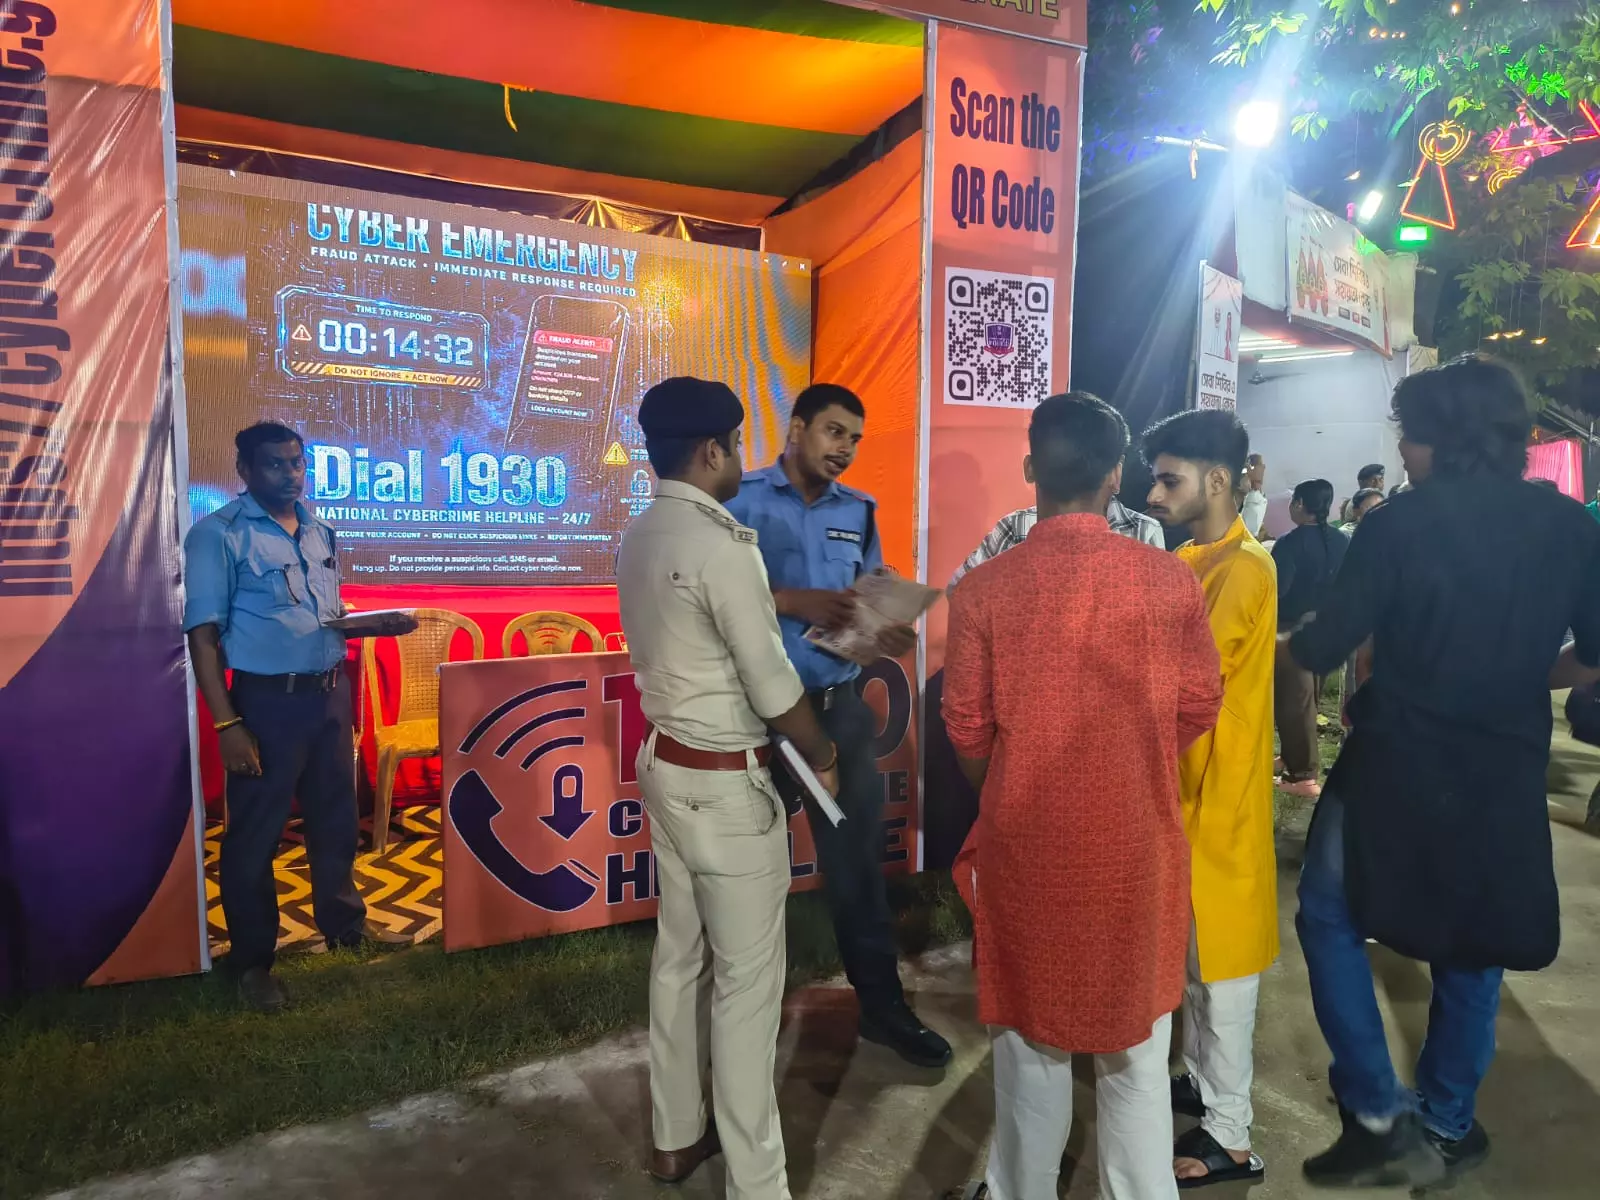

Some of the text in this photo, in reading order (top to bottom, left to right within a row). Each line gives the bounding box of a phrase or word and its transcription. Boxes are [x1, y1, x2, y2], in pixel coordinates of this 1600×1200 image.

[950, 76, 1061, 153] Scan the
[951, 163, 1056, 235] QR Code
[307, 202, 638, 282] CYBER EMERGENCY
[310, 246, 636, 298] FRAUD ATTACK IMMEDIATE RESPONSE REQUIRED
[355, 304, 433, 322] TIME TO RESPOND
[318, 319, 473, 366] 00:14:32
[549, 335, 572, 344] FRAUD
[334, 366, 449, 384] DO NOT IGNORE ACT NOW
[546, 407, 573, 415] ACCOUNT
[313, 445, 567, 507] Dial 1930
[315, 506, 389, 521] NATIONAL
[393, 508, 481, 523] CYBERCRIME
[485, 510, 545, 524] HELPLINE
[562, 512, 591, 525] 24/7
[352, 564, 374, 573] Hang
[415, 564, 443, 573] provide
[444, 565, 474, 573] personal
[520, 565, 540, 573] cyber
[540, 564, 567, 573] helpline
[397, 556, 413, 564] you
[414, 555, 443, 563] receive
[451, 555, 492, 564] suspicious
